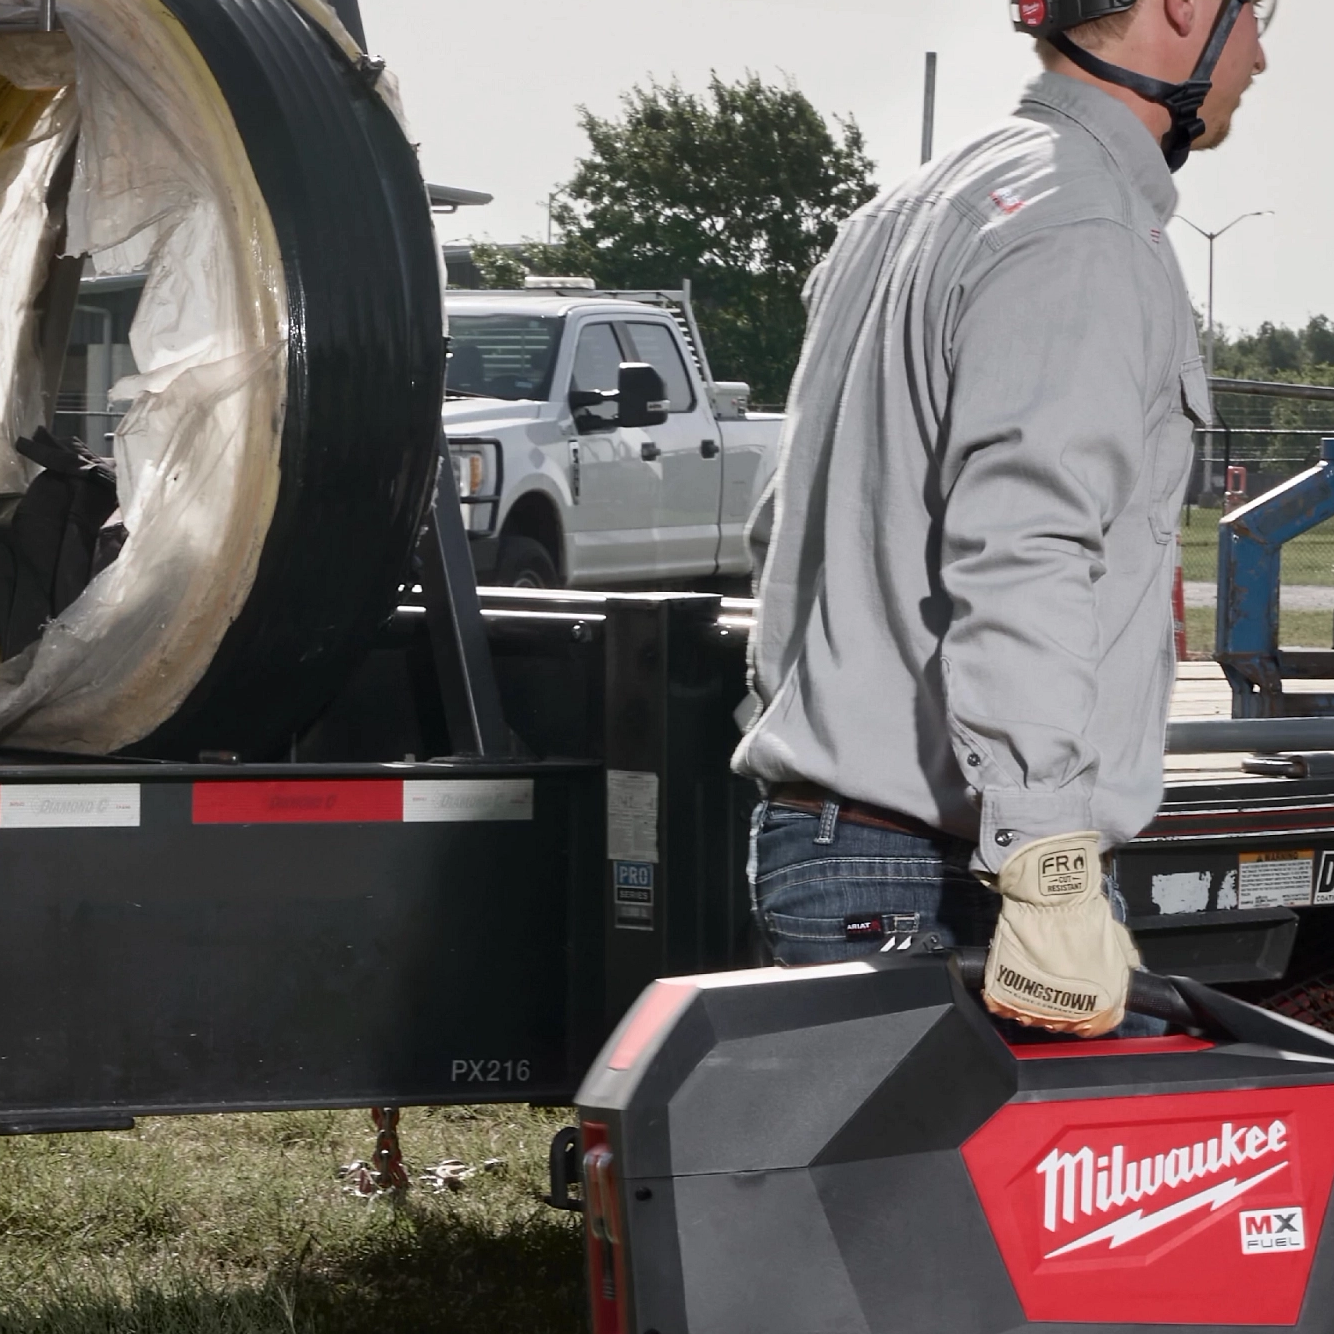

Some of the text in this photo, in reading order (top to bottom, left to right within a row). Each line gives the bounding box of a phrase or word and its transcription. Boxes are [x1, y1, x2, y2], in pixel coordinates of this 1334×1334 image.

[39, 799, 94, 814] DIAMOND
[1042, 855, 1070, 874] FR
[619, 866, 648, 885] PRO
[1047, 882, 1082, 892] RESISTANT
[847, 922, 871, 930] ARIAT
[996, 964, 1098, 1011] YOUNGSTOWN
[451, 1059, 531, 1081] PX216
[1036, 1120, 1287, 1232] Milwaukee
[1246, 1213, 1300, 1236] MX
[1247, 1237, 1301, 1249] FUEL
